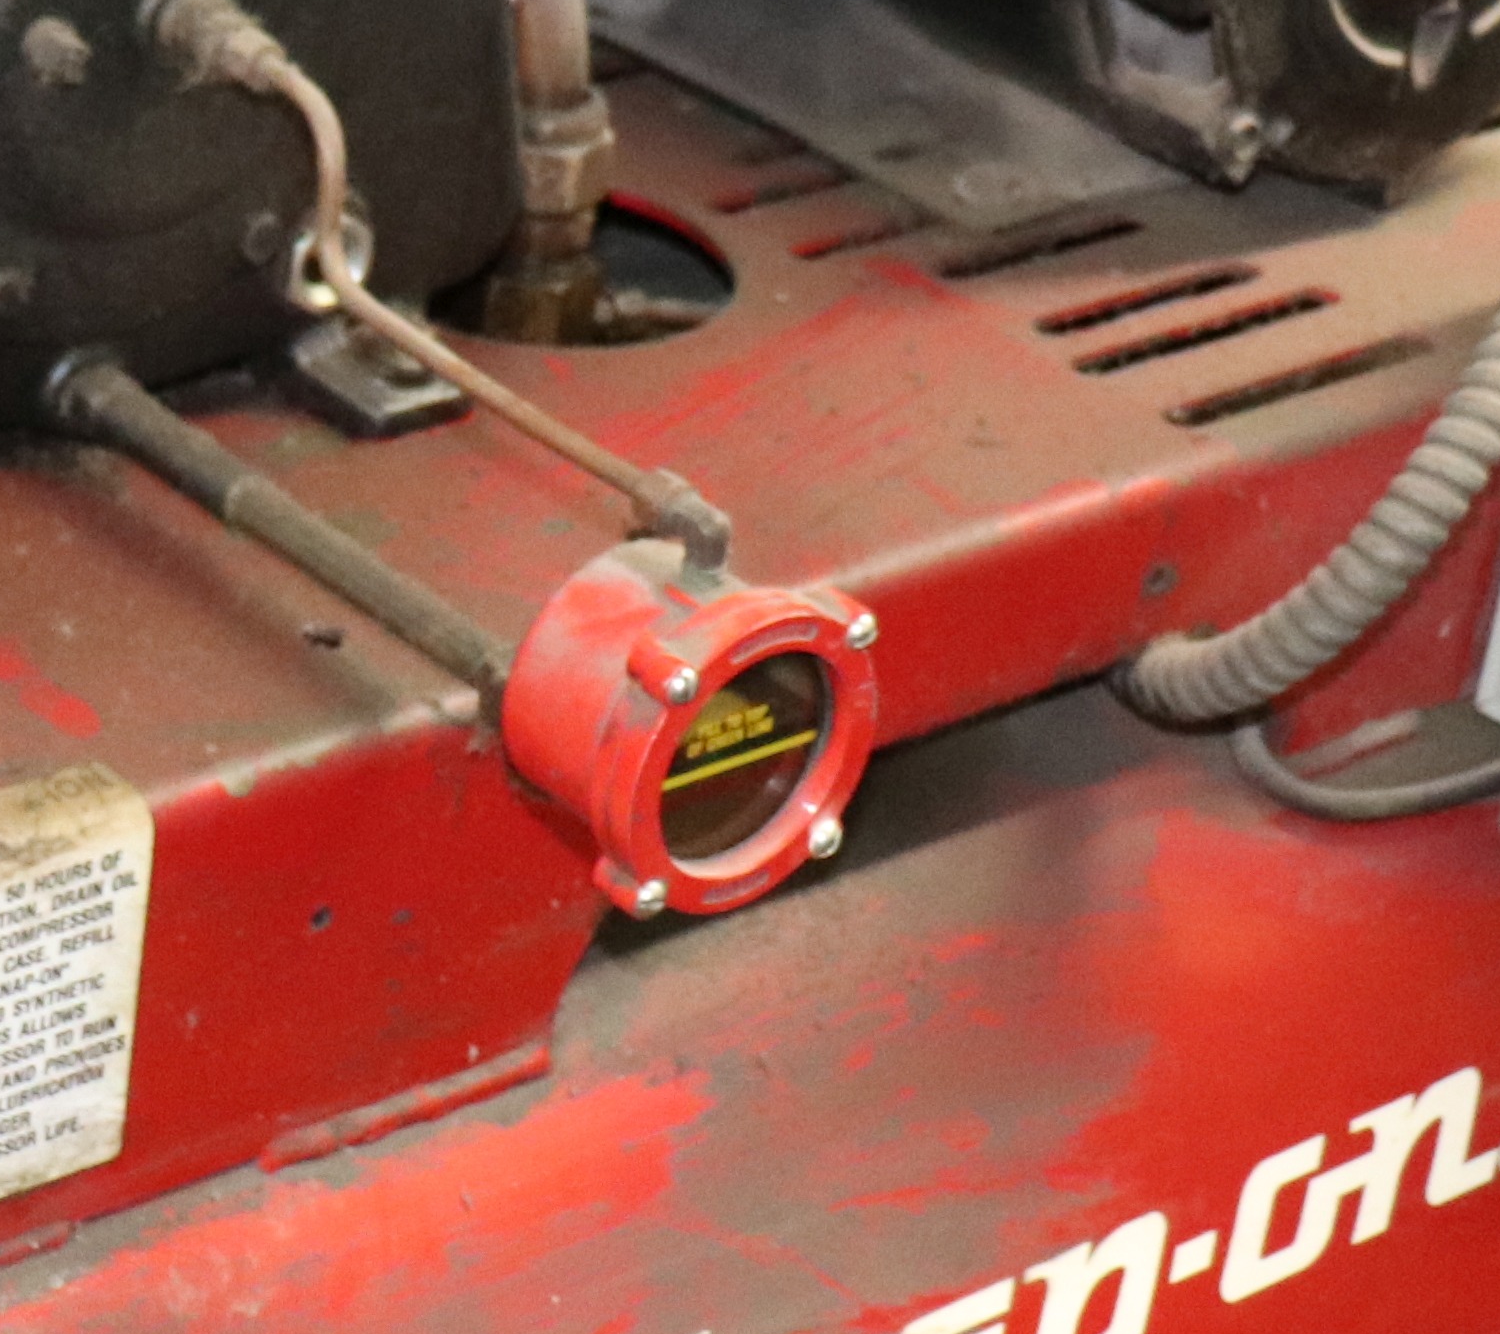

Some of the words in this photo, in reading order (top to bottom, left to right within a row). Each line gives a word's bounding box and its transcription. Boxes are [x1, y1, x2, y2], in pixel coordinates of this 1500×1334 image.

[7, 881, 26, 901] 50
[34, 859, 92, 893] HOURS
[101, 849, 121, 871] OF
[51, 879, 103, 910] DRAIN
[111, 868, 139, 891] OIL
[59, 923, 116, 955] REFILL
[13, 973, 104, 1015] SYNTHETIC
[20, 1001, 86, 1036] ALLOWS
[53, 1029, 73, 1048] TO
[81, 1013, 117, 1038] RUN
[2, 1064, 36, 1087] AND
[44, 1033, 126, 1073] PROVIDES
